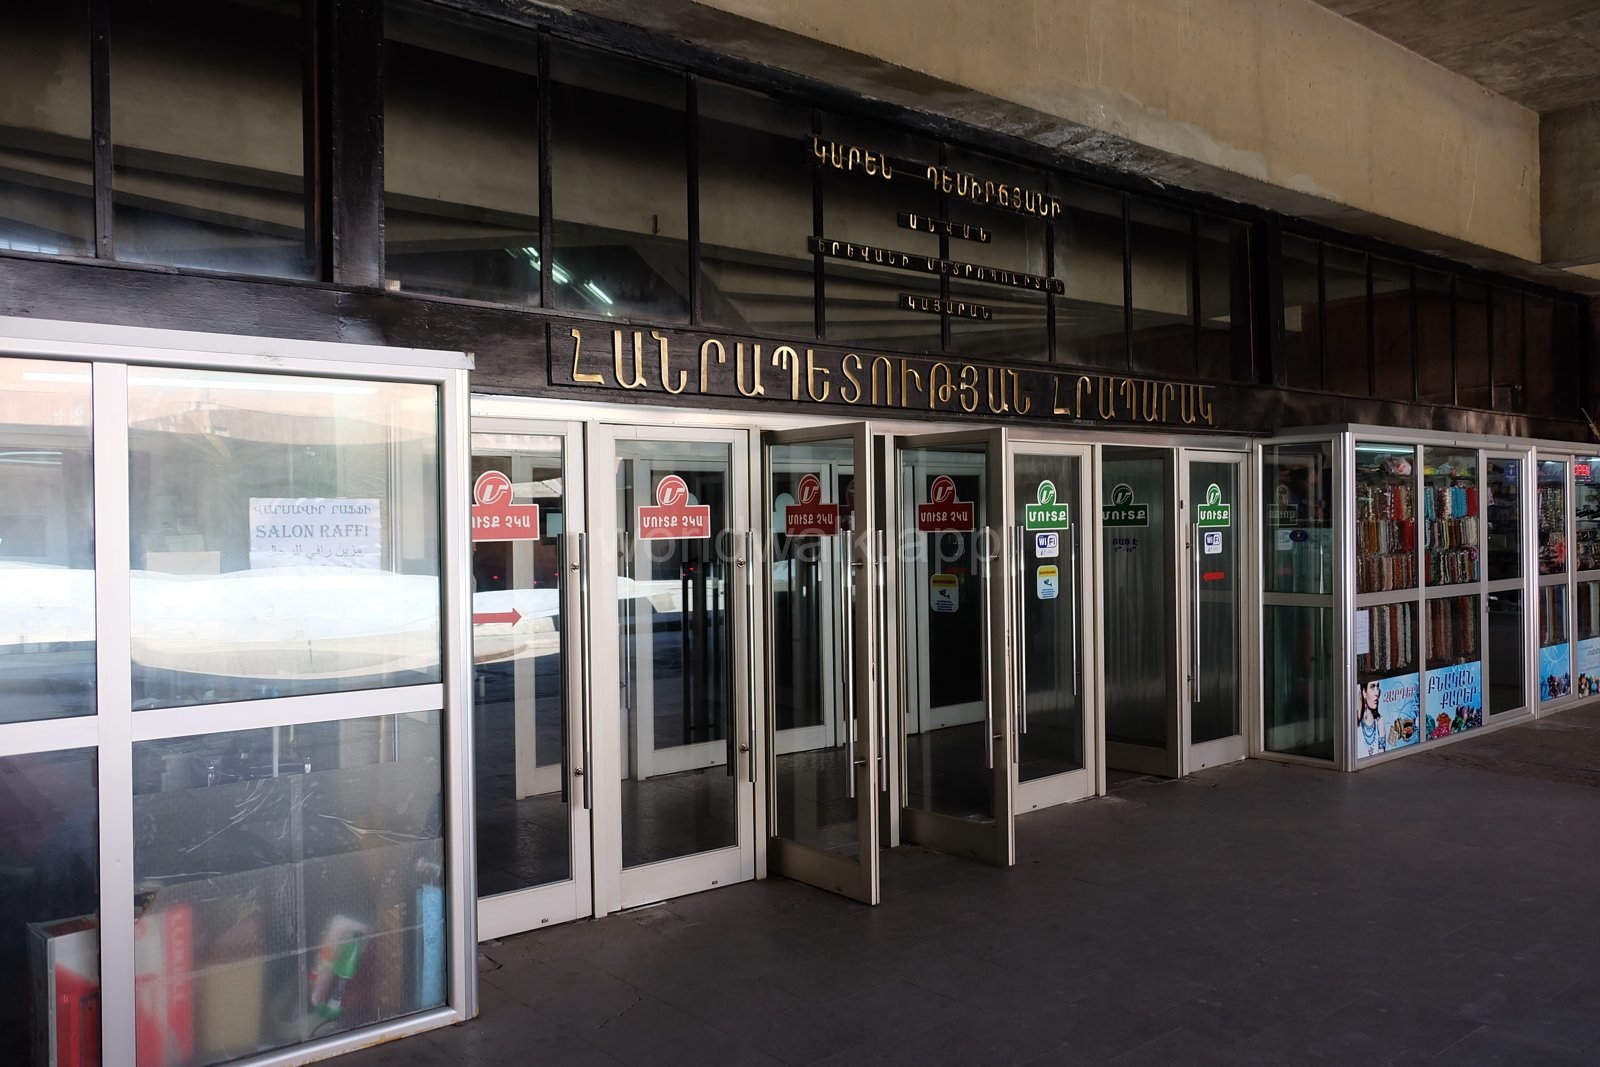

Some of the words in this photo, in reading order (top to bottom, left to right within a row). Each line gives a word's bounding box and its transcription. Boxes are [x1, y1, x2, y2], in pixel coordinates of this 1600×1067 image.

[812, 136, 893, 180] ԿԱՐԵՆ
[926, 165, 1063, 218] ԴԵՄԻՐՃՅԱՆԻ
[909, 212, 987, 242] ԱՆՎԱՆ
[818, 239, 909, 267] ԵՐԵՎԱՆԻ
[908, 295, 989, 319] ԿԱՅԱՐԱՆ
[570, 328, 1032, 415] ՀԱՆՐԱՊԵՏՈՒԹՅԱՆ
[1053, 376, 1217, 425] ՀՐԱՊԱՐԱԿ
[472, 515, 500, 529] ՈՒՏՔ
[505, 514, 531, 528] ՉԿԱ
[643, 515, 678, 528] ՄՈՒՏՔ
[682, 514, 704, 528] ՉԿԱ
[788, 513, 814, 526] ՄՈՒՏՔ
[816, 513, 834, 525] ՉԿԱ
[920, 512, 948, 523] ՄՈՒՏՔ
[950, 511, 969, 522] ՉԿԱ
[1029, 510, 1067, 523] ՄՈՒՏՔ
[1102, 510, 1146, 521] ՄՈՒՏՔ
[1200, 510, 1229, 521] ՄՈՒՏՔ
[255, 524, 315, 538] SALON
[319, 524, 369, 538] RAFFI
[1439, 687, 1477, 710] ՔԱՐԵՐ
